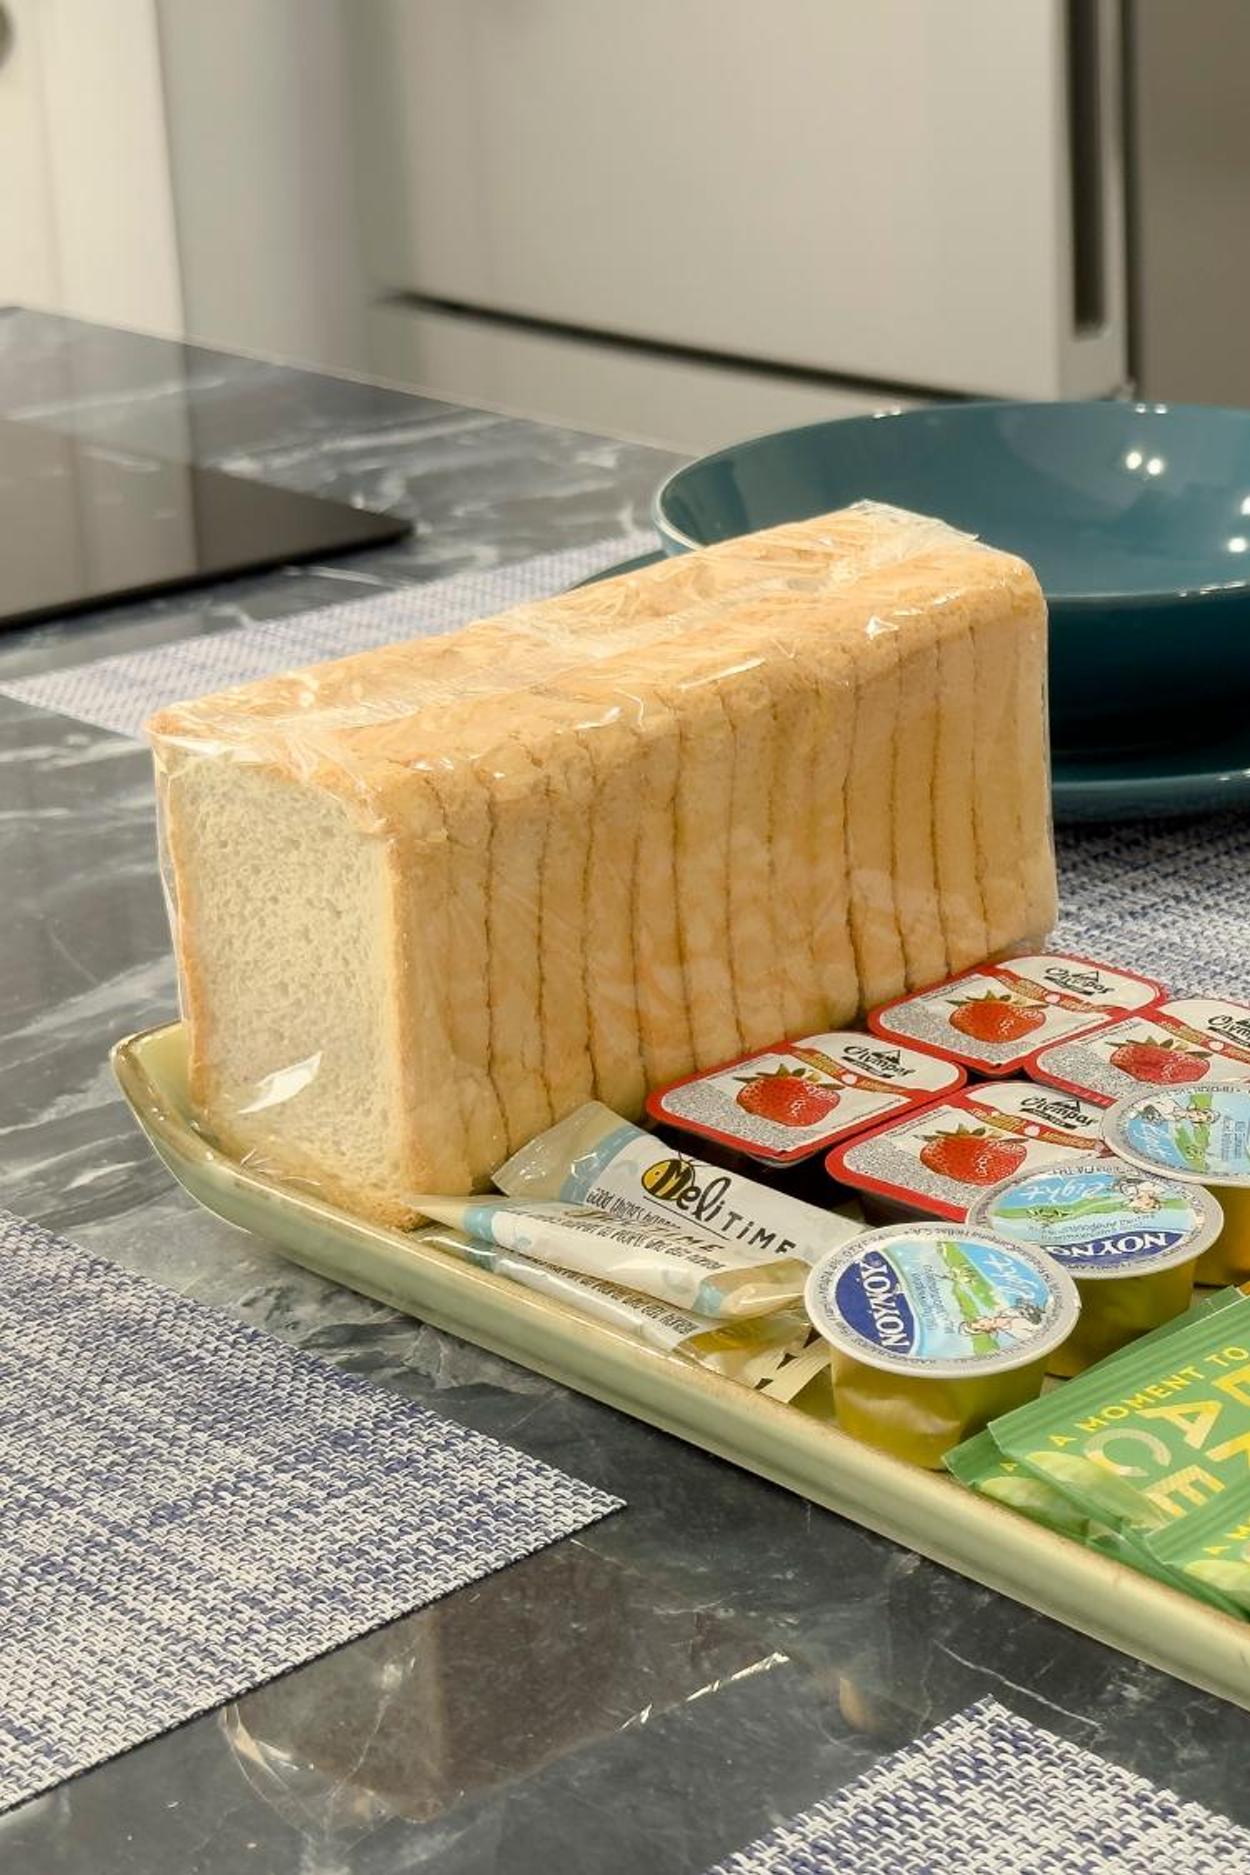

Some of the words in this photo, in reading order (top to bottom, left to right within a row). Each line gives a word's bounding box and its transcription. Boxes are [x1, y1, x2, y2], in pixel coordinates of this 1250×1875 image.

[1046, 1231, 1169, 1258] NOYNO
[857, 1258, 912, 1348] NOYNOY
[1049, 1433, 1078, 1447] A
[1075, 1365, 1206, 1435] MOMENT
[1204, 1345, 1250, 1368] TO
